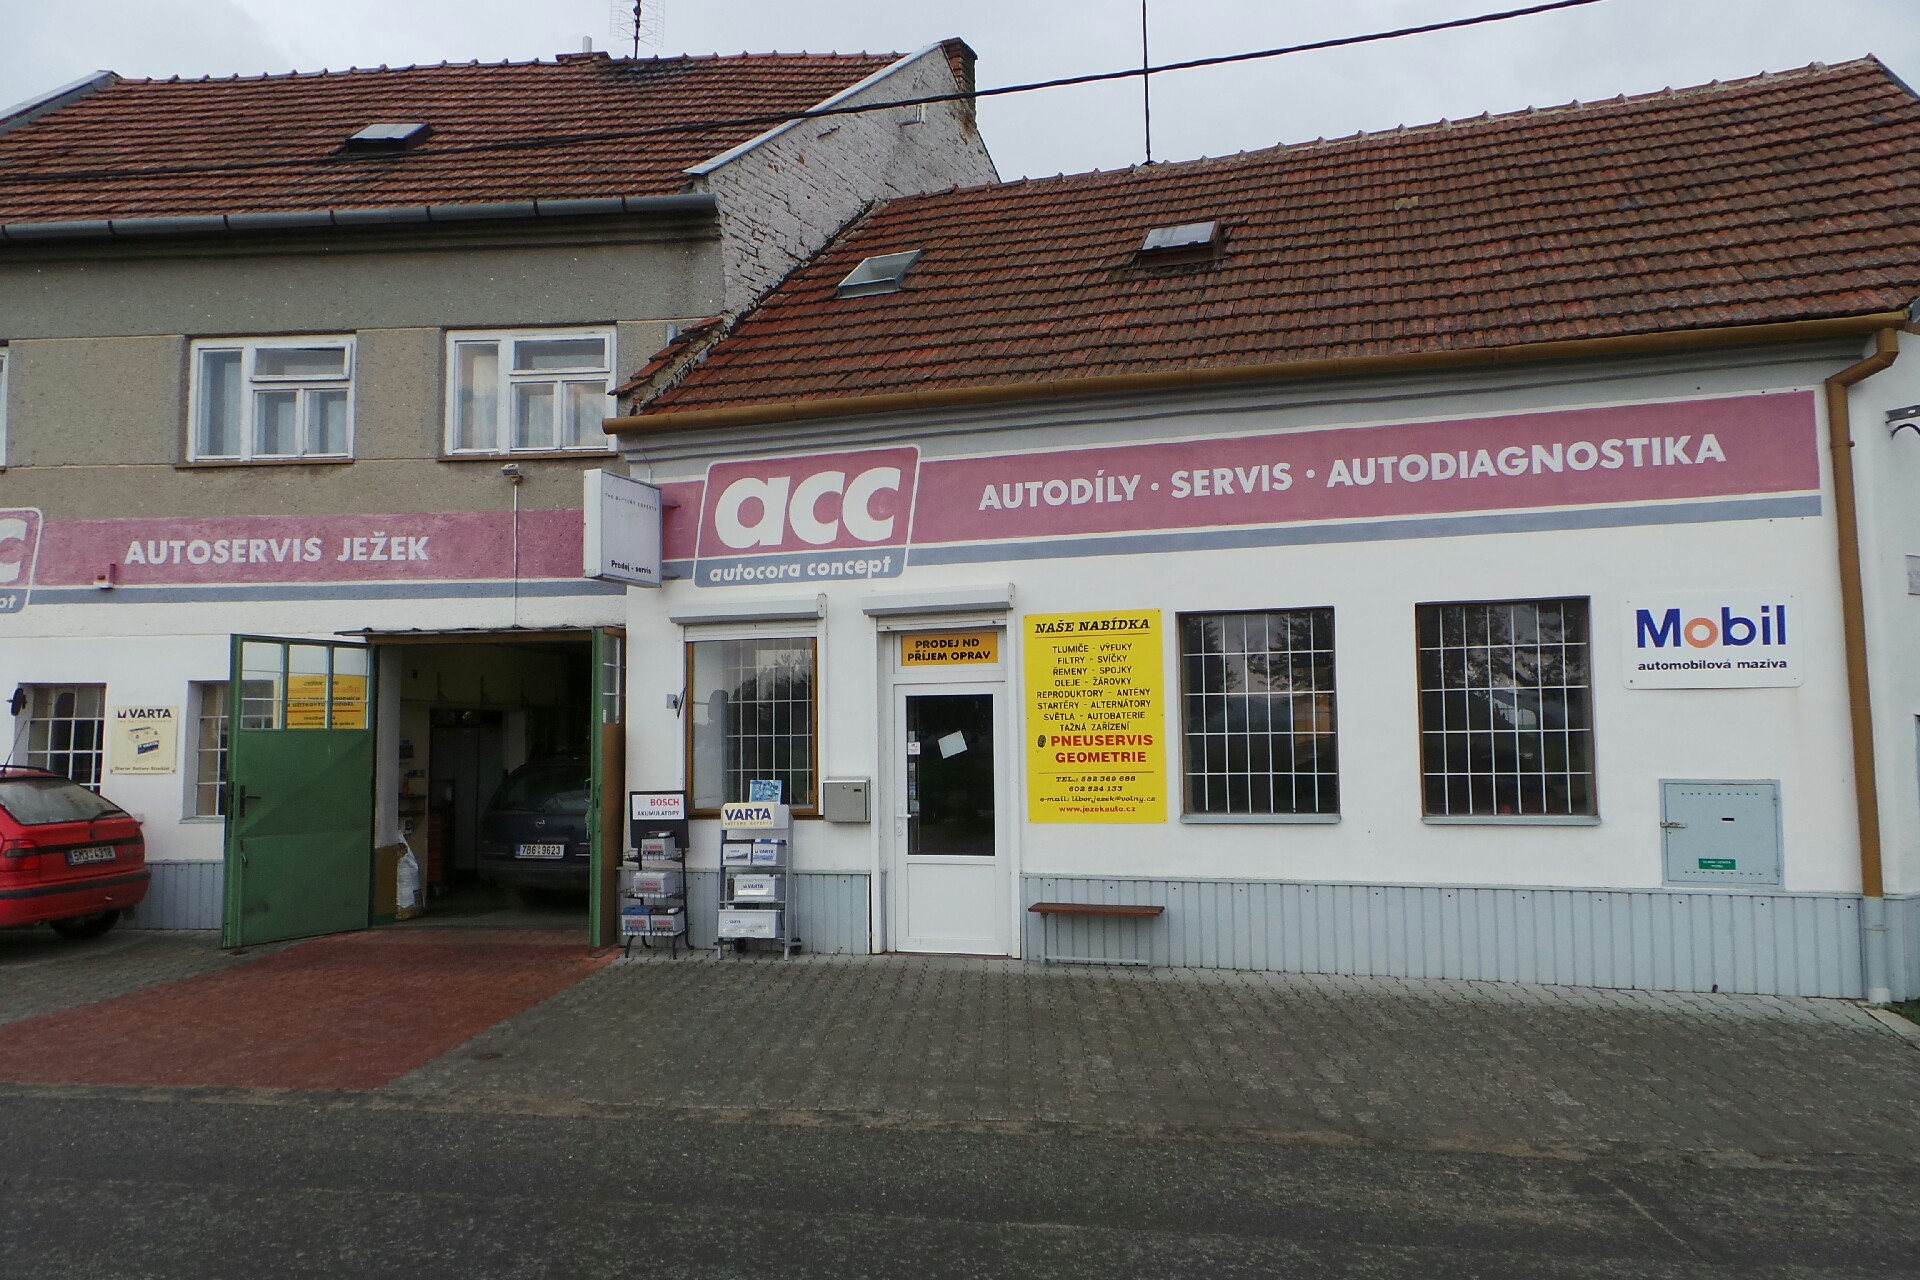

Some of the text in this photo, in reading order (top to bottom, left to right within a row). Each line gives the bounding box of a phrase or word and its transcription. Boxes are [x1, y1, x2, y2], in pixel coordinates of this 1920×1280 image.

[979, 433, 1727, 511] AUTODÍLY SERVIS AUTODIAGNOSTIKA
[715, 467, 901, 549] acc
[124, 531, 429, 566] AUTOSERVIS JEŽEK
[611, 560, 630, 572] Prodej
[635, 566, 652, 575] servis
[709, 556, 891, 582] autocora concept
[1034, 617, 1151, 634] NAŠE NABÍDKA
[1636, 605, 1787, 648] Mobil
[915, 638, 980, 649] PRODEJ ND
[1053, 643, 1089, 653] TLUMIČE
[1099, 643, 1133, 652] VÝFUKY
[907, 650, 991, 661] PŘÍJEM OPRAV
[1057, 656, 1085, 665] FILTRY
[1097, 653, 1128, 664] SVÍČKY
[1638, 658, 1788, 671] automobilová maziva
[1053, 667, 1088, 676] ŘEMENY
[1099, 666, 1132, 675] SPOJKY
[1054, 678, 1081, 687] OLEJE
[1092, 677, 1132, 686] ŽÁROVKY
[1036, 689, 1104, 699] REPRODUKTORY
[1116, 687, 1151, 697] ANTÉNY
[1037, 700, 1080, 710] STARTÉRY
[1090, 699, 1152, 709] ALTERNÁTORY
[128, 708, 172, 719] VARTA
[1043, 712, 1075, 721] SVĚTLA
[1087, 711, 1146, 720] AUTOBATERIE
[1060, 721, 1131, 732] TAŽNÁ ZAŘÍZENÍ
[1050, 734, 1154, 747] PNEUSERVIS
[1055, 751, 1147, 763] GEOMETRIE
[650, 798, 680, 807] BOSCH
[724, 808, 772, 821] VARTA
[1058, 805, 1136, 813] www.jezekauto.cz
[541, 845, 561, 855] 9623
